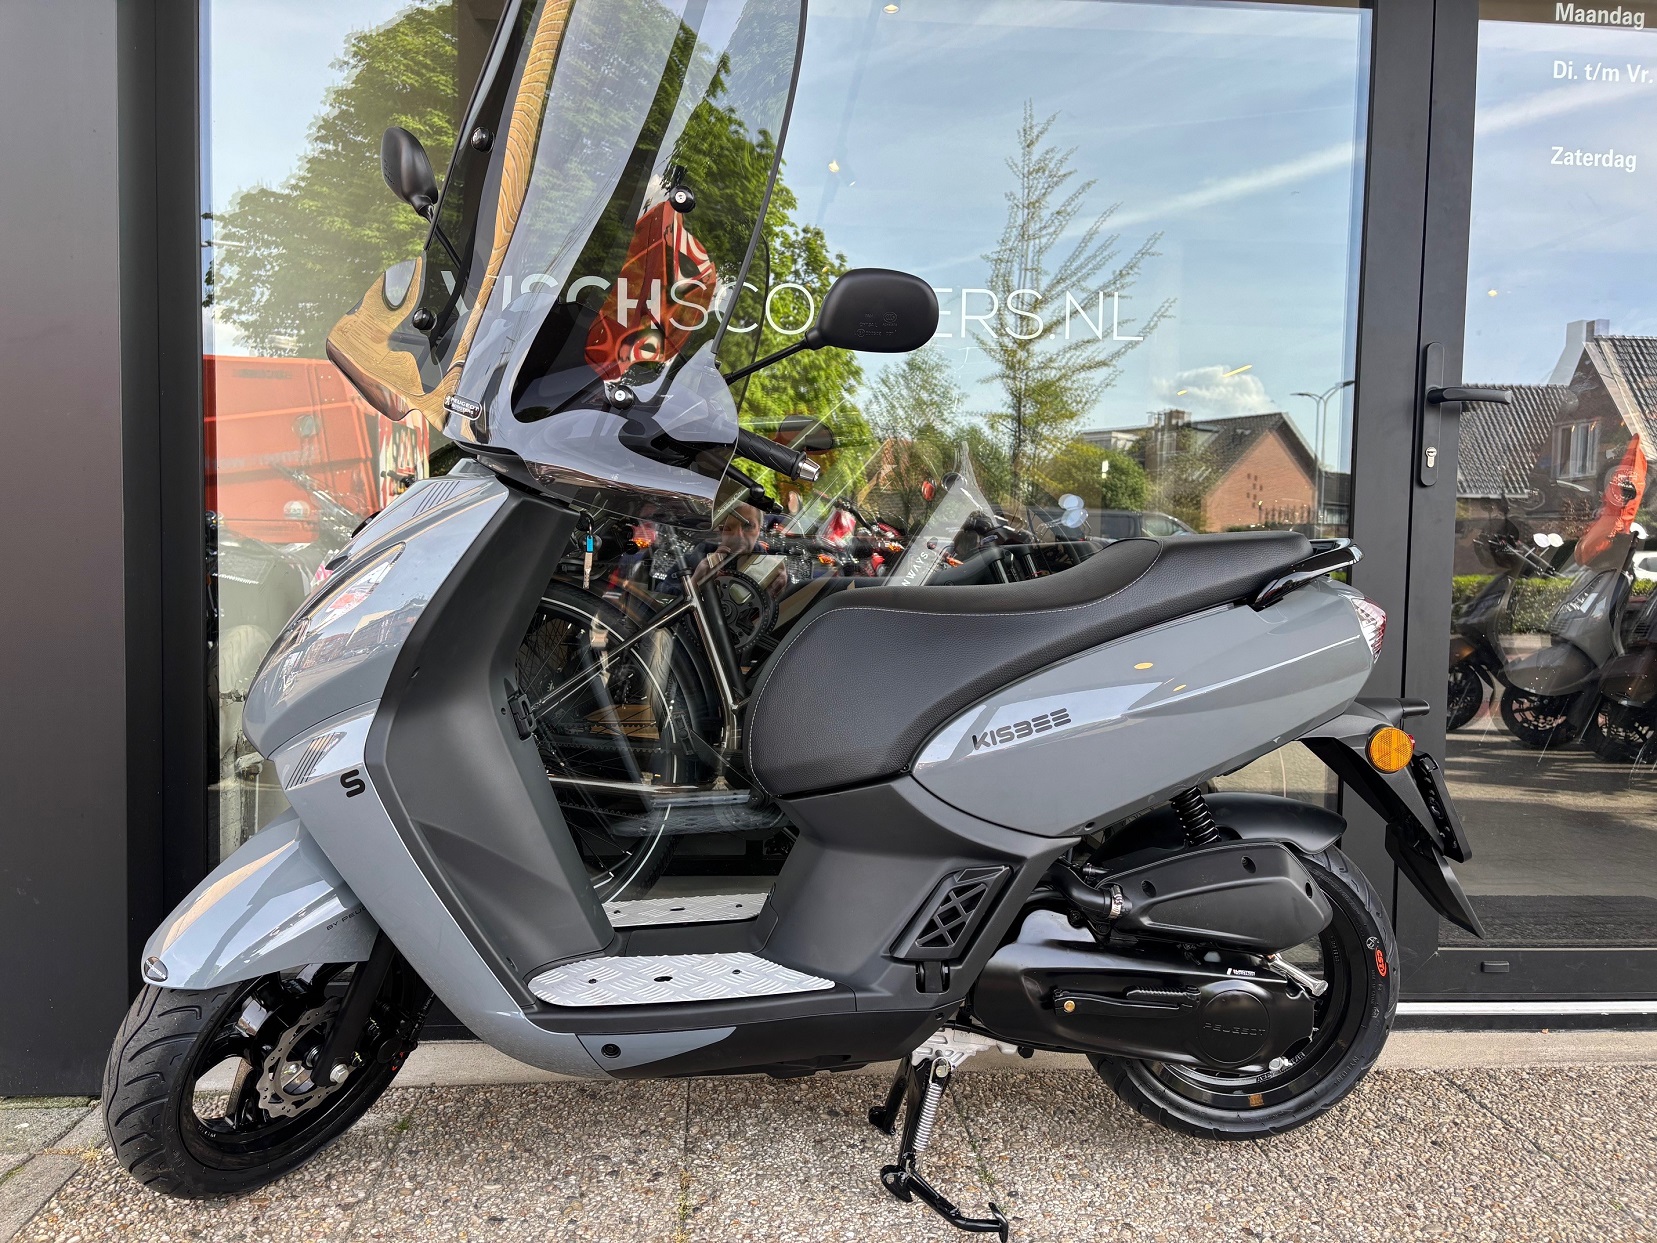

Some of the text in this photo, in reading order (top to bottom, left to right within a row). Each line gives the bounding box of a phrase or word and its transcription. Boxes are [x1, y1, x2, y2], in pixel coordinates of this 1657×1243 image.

[1555, 2, 1645, 30] Maandag
[1553, 60, 1654, 84] Di. t/m Vr.
[1550, 146, 1637, 173] Zaterdag
[971, 707, 1072, 751] KISBEE
[339, 768, 366, 798] S
